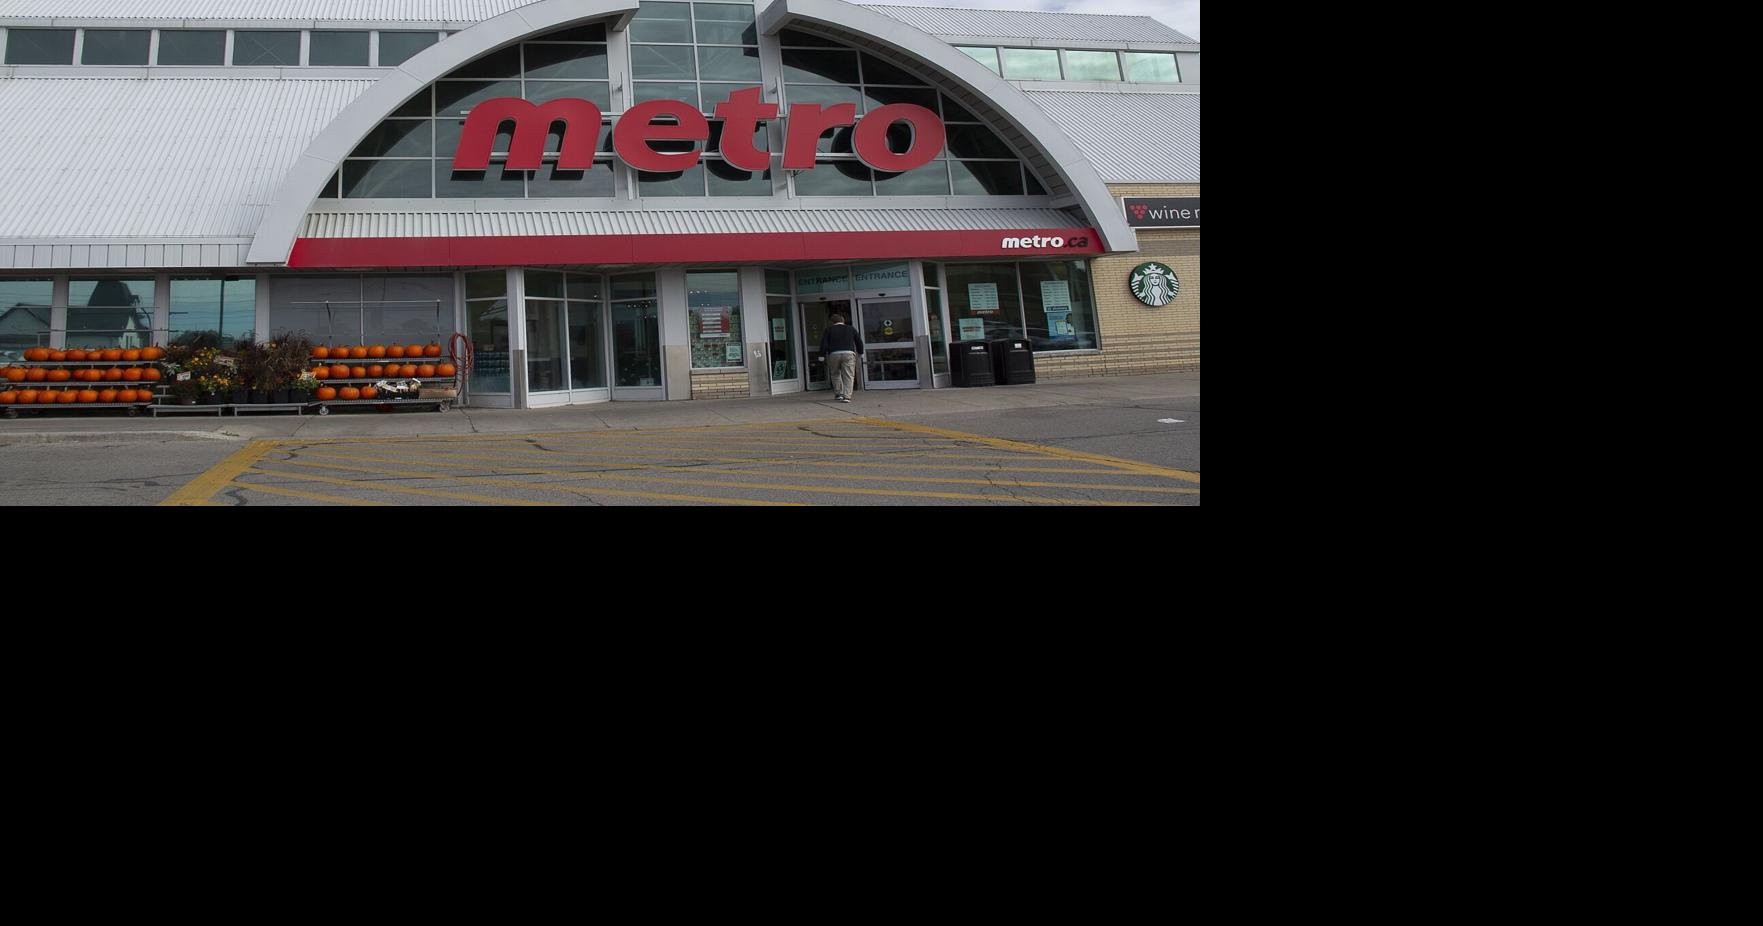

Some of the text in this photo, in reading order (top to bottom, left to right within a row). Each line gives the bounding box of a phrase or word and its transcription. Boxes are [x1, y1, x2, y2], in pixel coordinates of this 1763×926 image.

[452, 86, 946, 173] metro
[1148, 205, 1191, 220] wine
[1001, 235, 1089, 249] metro.ca
[855, 270, 909, 281] ENTRANCE
